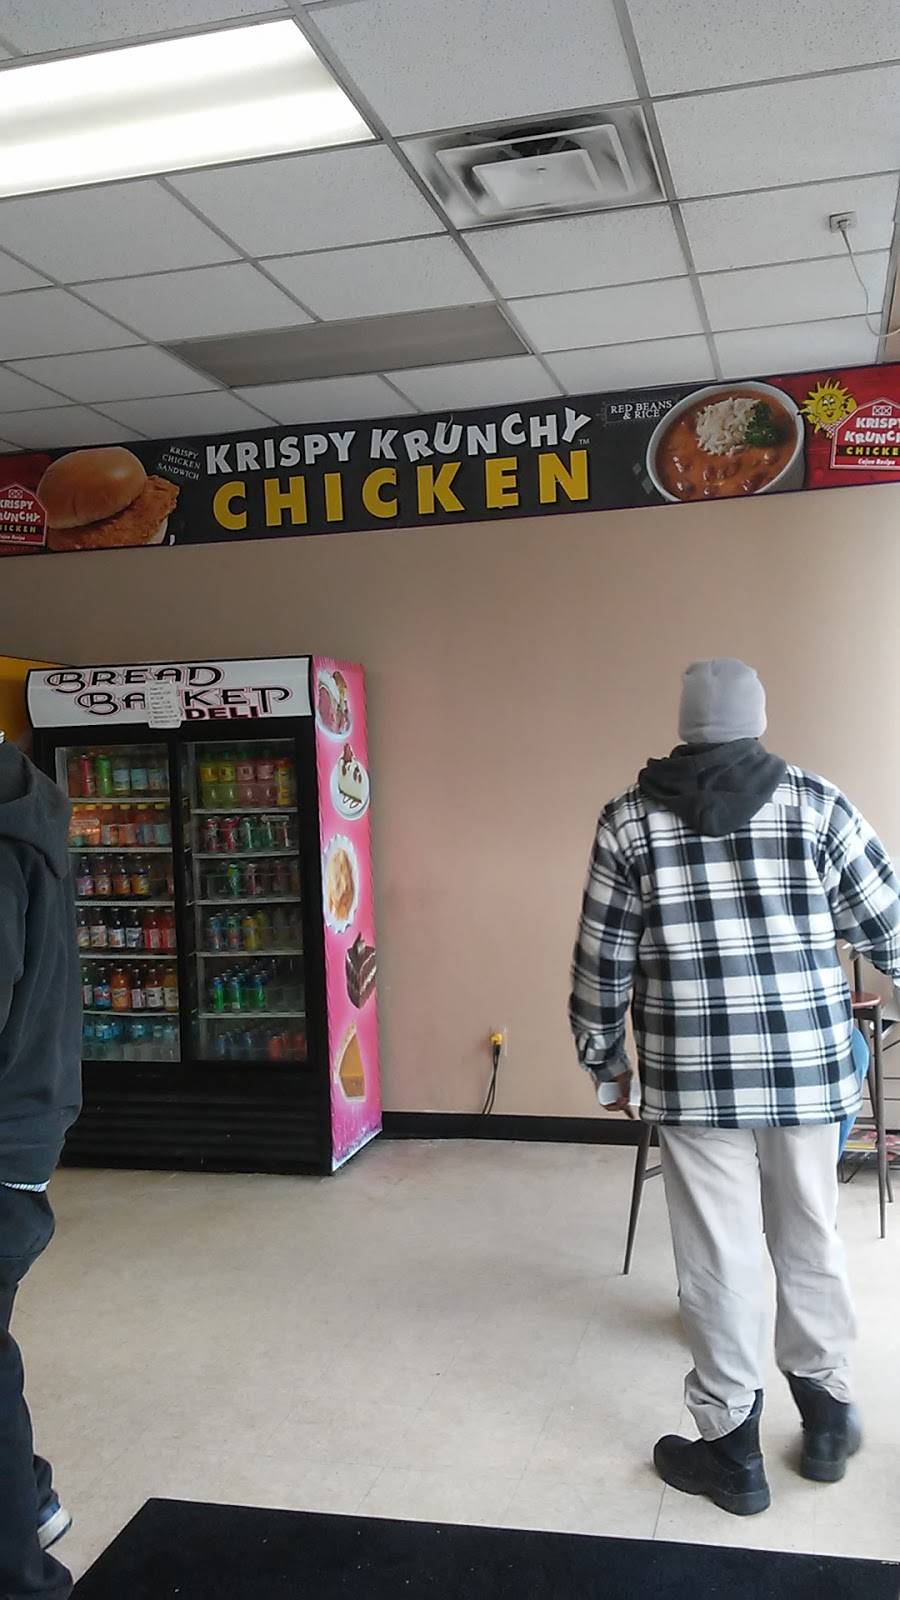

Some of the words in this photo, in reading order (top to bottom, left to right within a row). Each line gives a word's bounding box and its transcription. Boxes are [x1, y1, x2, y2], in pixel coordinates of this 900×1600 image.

[611, 404, 633, 414] RED
[636, 400, 673, 411] BEANS
[623, 411, 632, 420] &
[635, 409, 660, 419] RICE
[855, 417, 900, 429] KRISP
[206, 429, 355, 475] KRISPY
[371, 407, 591, 463] KRUNCHY
[170, 446, 199, 459] KRISPY
[162, 454, 200, 469] CHICKEN
[158, 462, 200, 480] SANDWICH
[213, 450, 590, 530] CHICKEN
[0, 525, 36, 533] ICKEN
[46, 665, 223, 694] BREAD
[77, 687, 290, 715] BAKET
[185, 706, 260, 721] DELI
